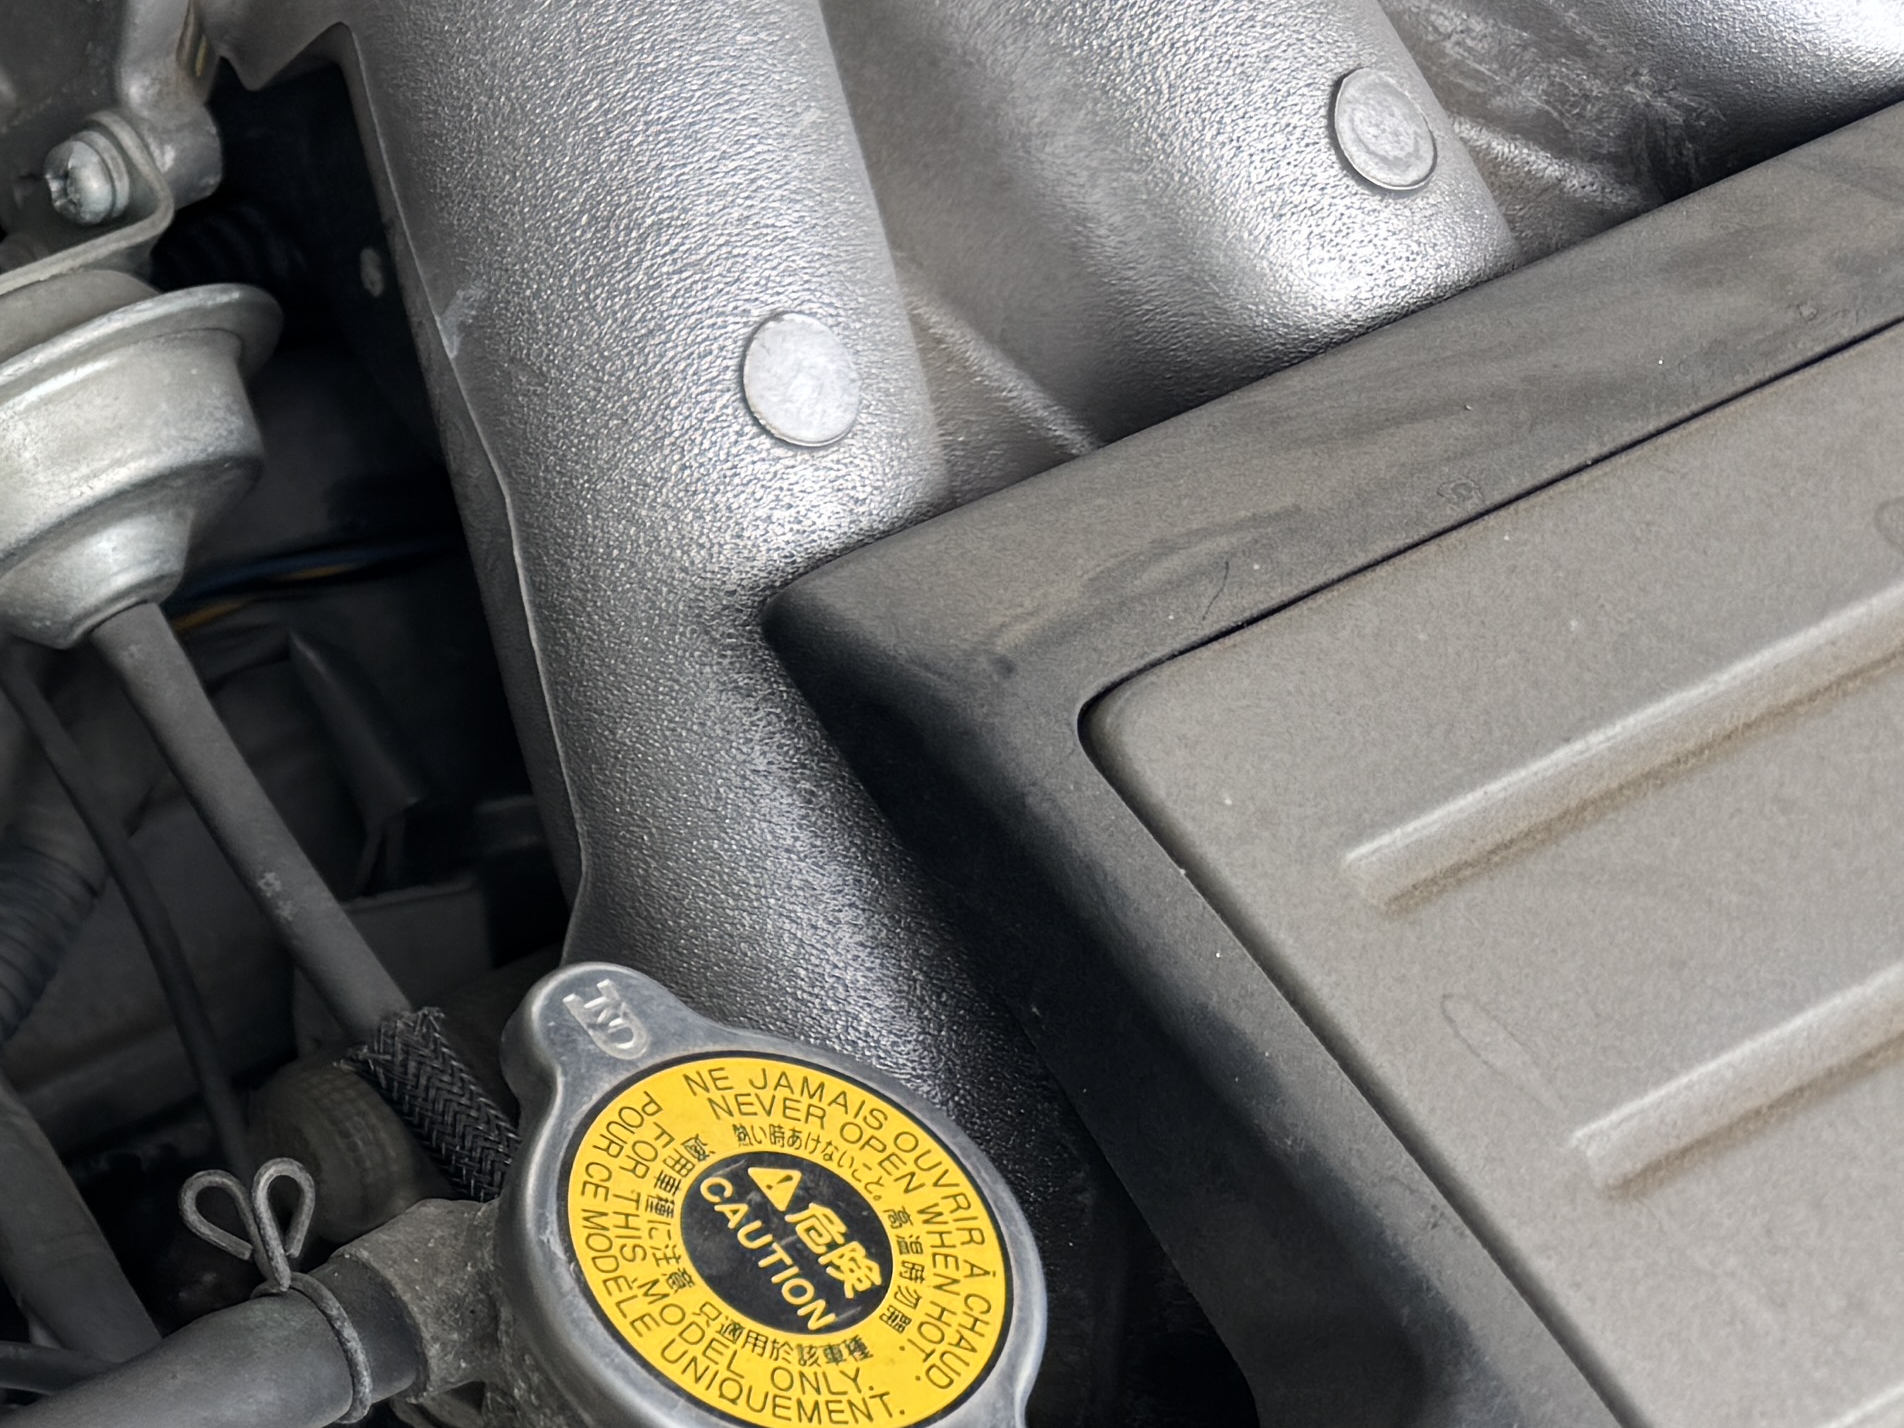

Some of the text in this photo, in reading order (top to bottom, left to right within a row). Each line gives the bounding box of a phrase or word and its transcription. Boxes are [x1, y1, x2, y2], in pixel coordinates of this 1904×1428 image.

[682, 1067, 734, 1097] NE
[748, 1067, 888, 1131] JAMAIS
[893, 1130, 986, 1246] OUVRIR
[706, 1092, 827, 1131] NEVER
[839, 1121, 926, 1195] OPEN
[916, 1202, 961, 1296] WHEN
[784, 1202, 883, 1300] 危険
[580, 1090, 906, 1426] POUR CE MODÈLE UNIQUEMENT.
[611, 1120, 875, 1393] FOR THIS MODEL ONLY.
[699, 1175, 837, 1331] CAUTION
